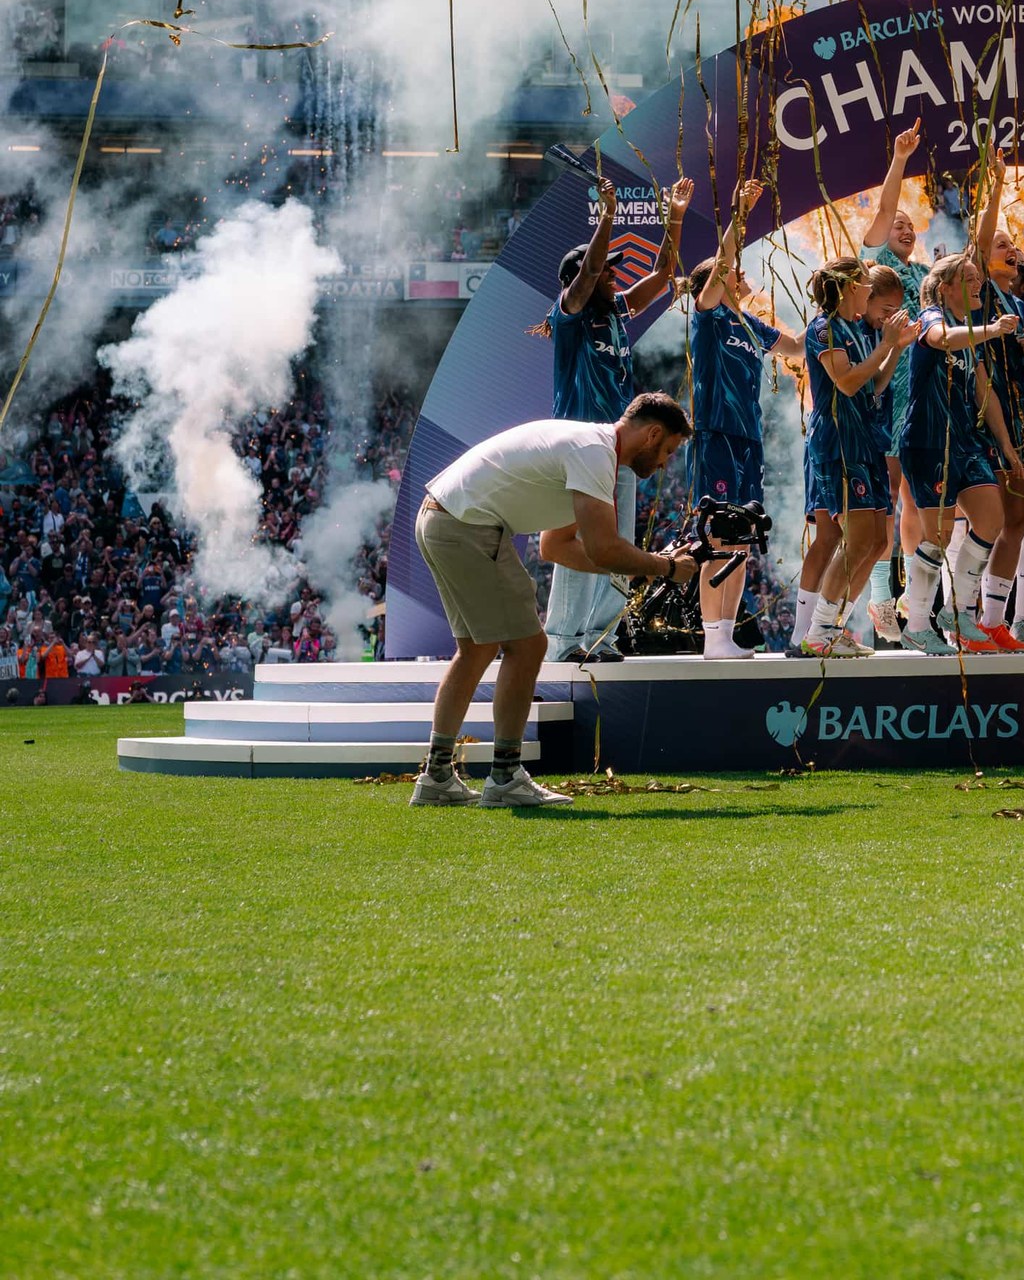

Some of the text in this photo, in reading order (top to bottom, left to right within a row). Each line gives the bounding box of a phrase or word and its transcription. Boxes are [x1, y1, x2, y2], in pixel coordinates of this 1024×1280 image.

[840, 8, 945, 51] BARCLAYS
[612, 186, 671, 200] ARCLA
[588, 201, 670, 216] WMEN'S
[588, 216, 624, 226] SUER
[726, 504, 746, 514] RONIN
[818, 703, 1019, 740] BARCLAYS
